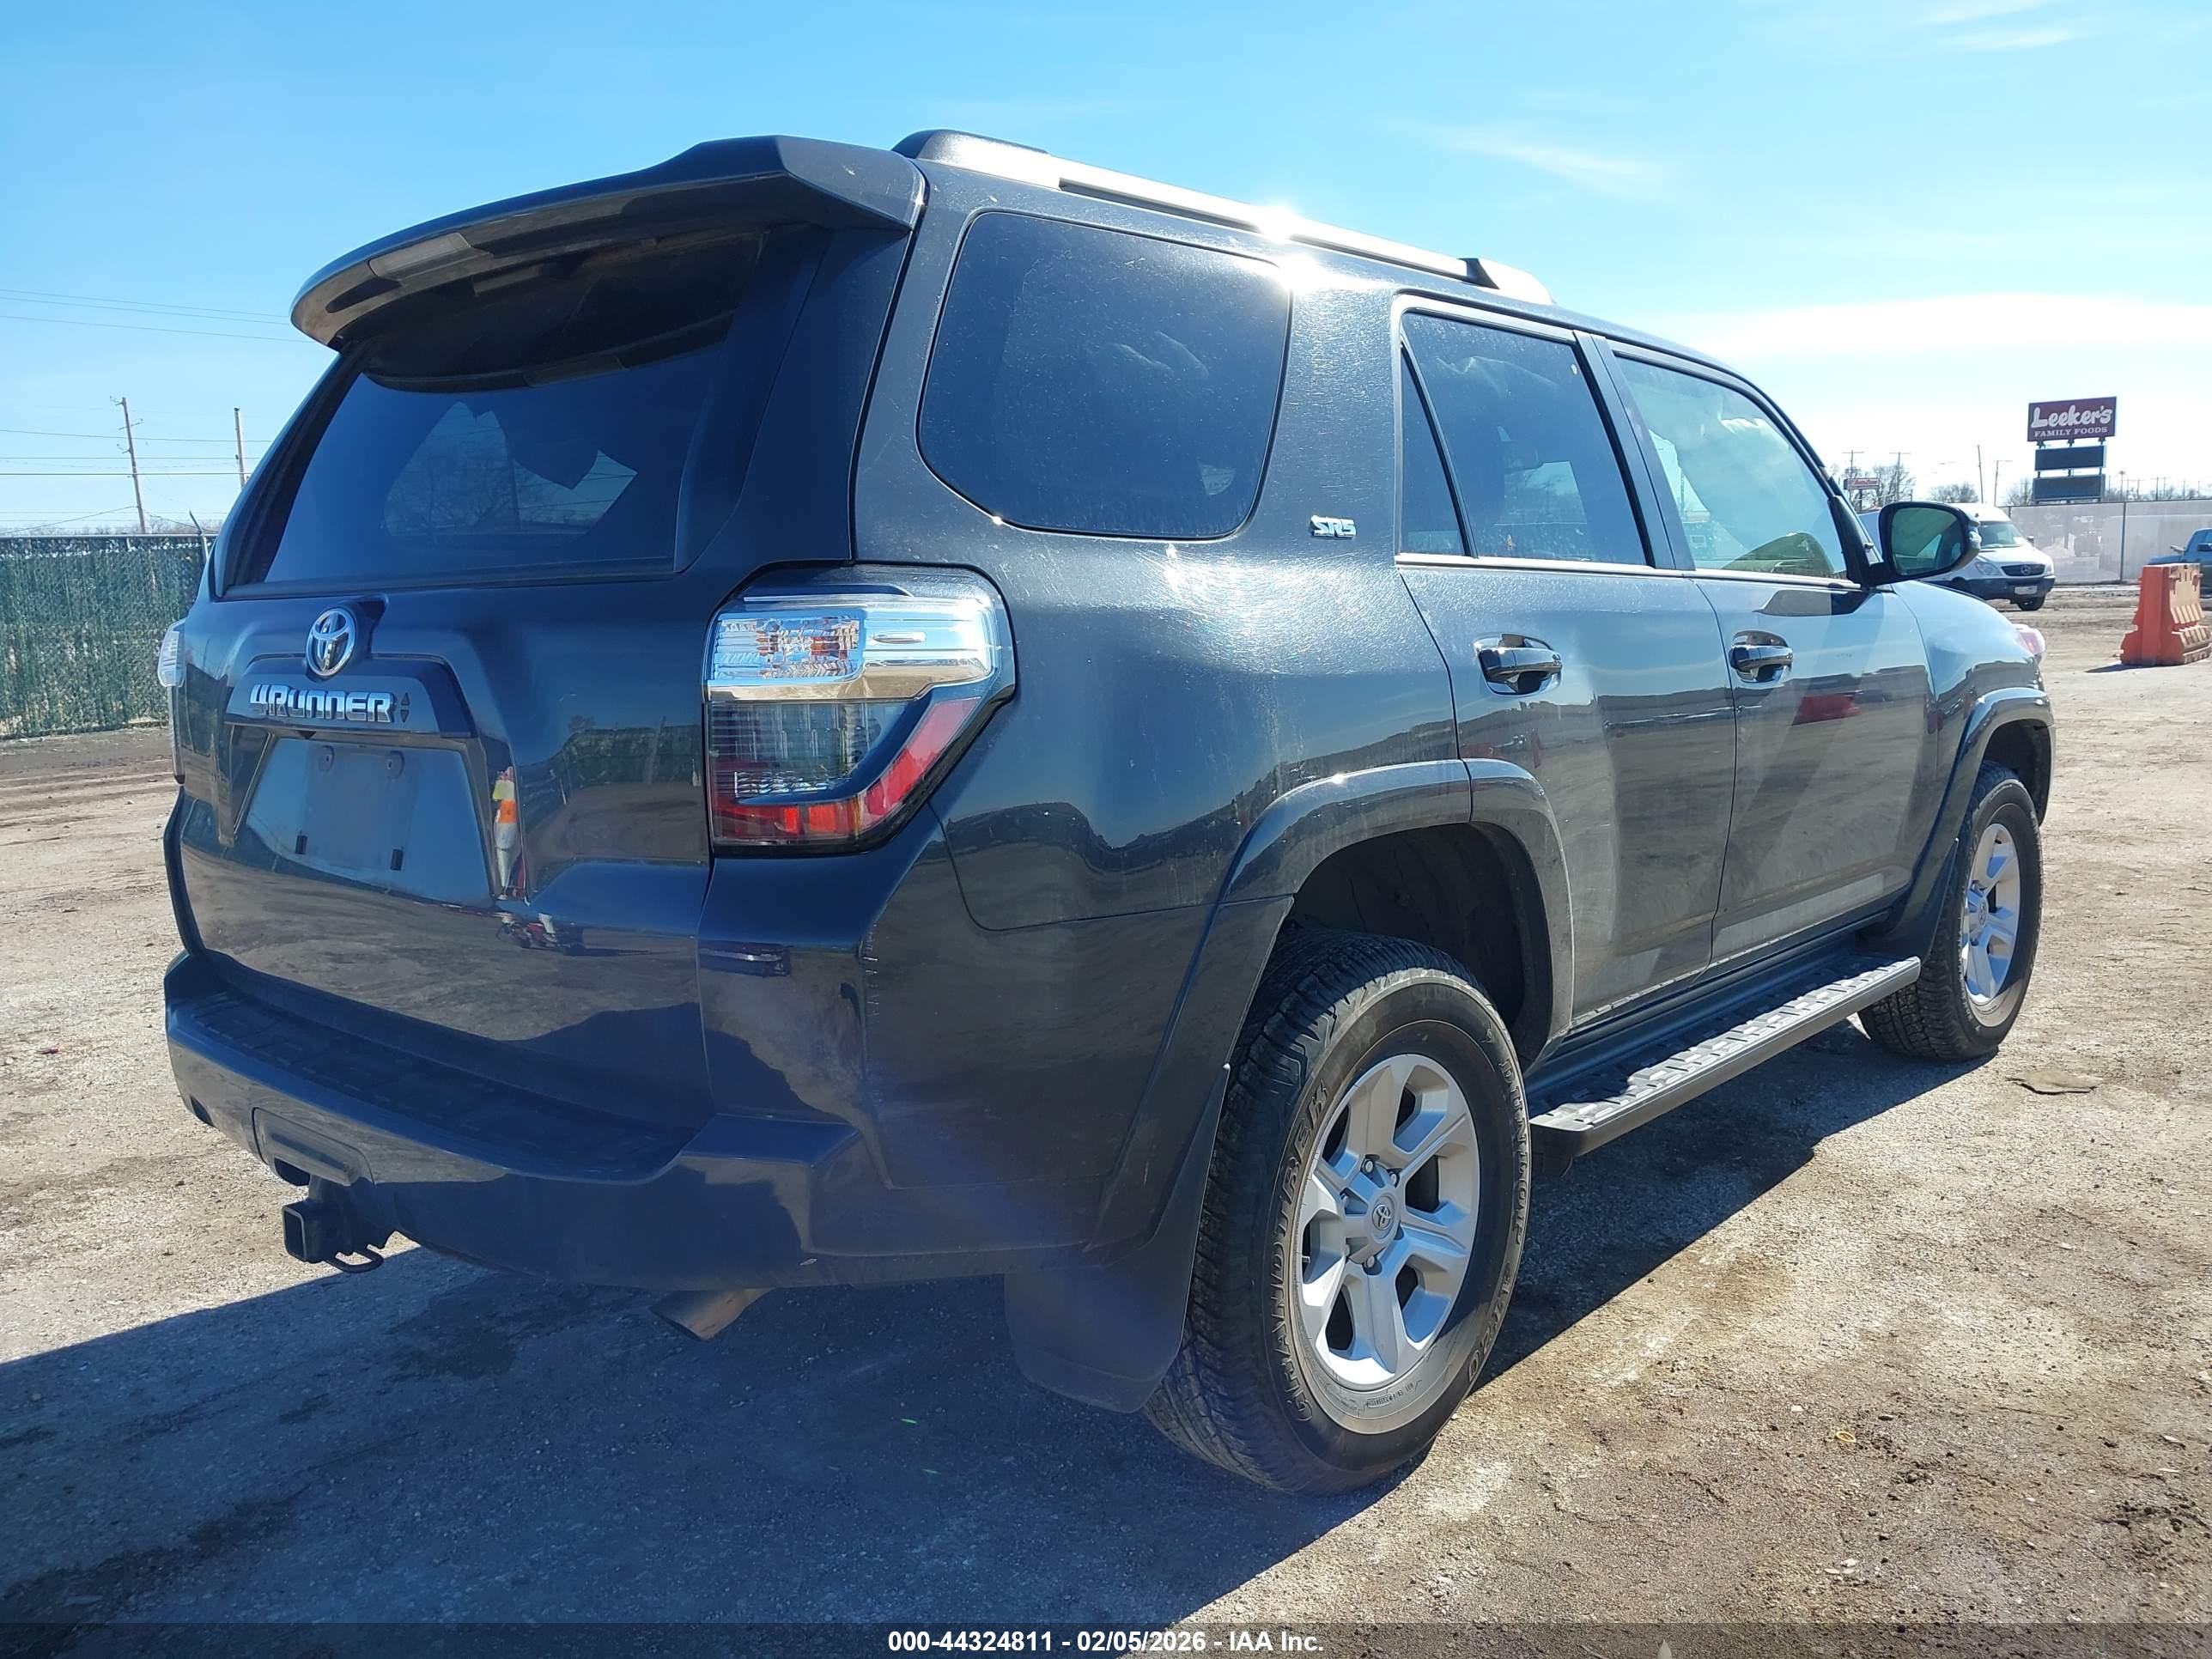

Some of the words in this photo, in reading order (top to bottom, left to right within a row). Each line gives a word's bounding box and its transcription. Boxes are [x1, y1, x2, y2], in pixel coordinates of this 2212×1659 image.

[2030, 404, 2113, 428] Leeker's
[2034, 428, 2072, 438] FAMILY
[2074, 426, 2108, 434] FOODS
[1310, 514, 1357, 538] SR5
[249, 684, 394, 723] 4RUNNER
[1498, 1057, 1528, 1245] DUNLOP
[1270, 1078, 1328, 1422] GRANDTREK
